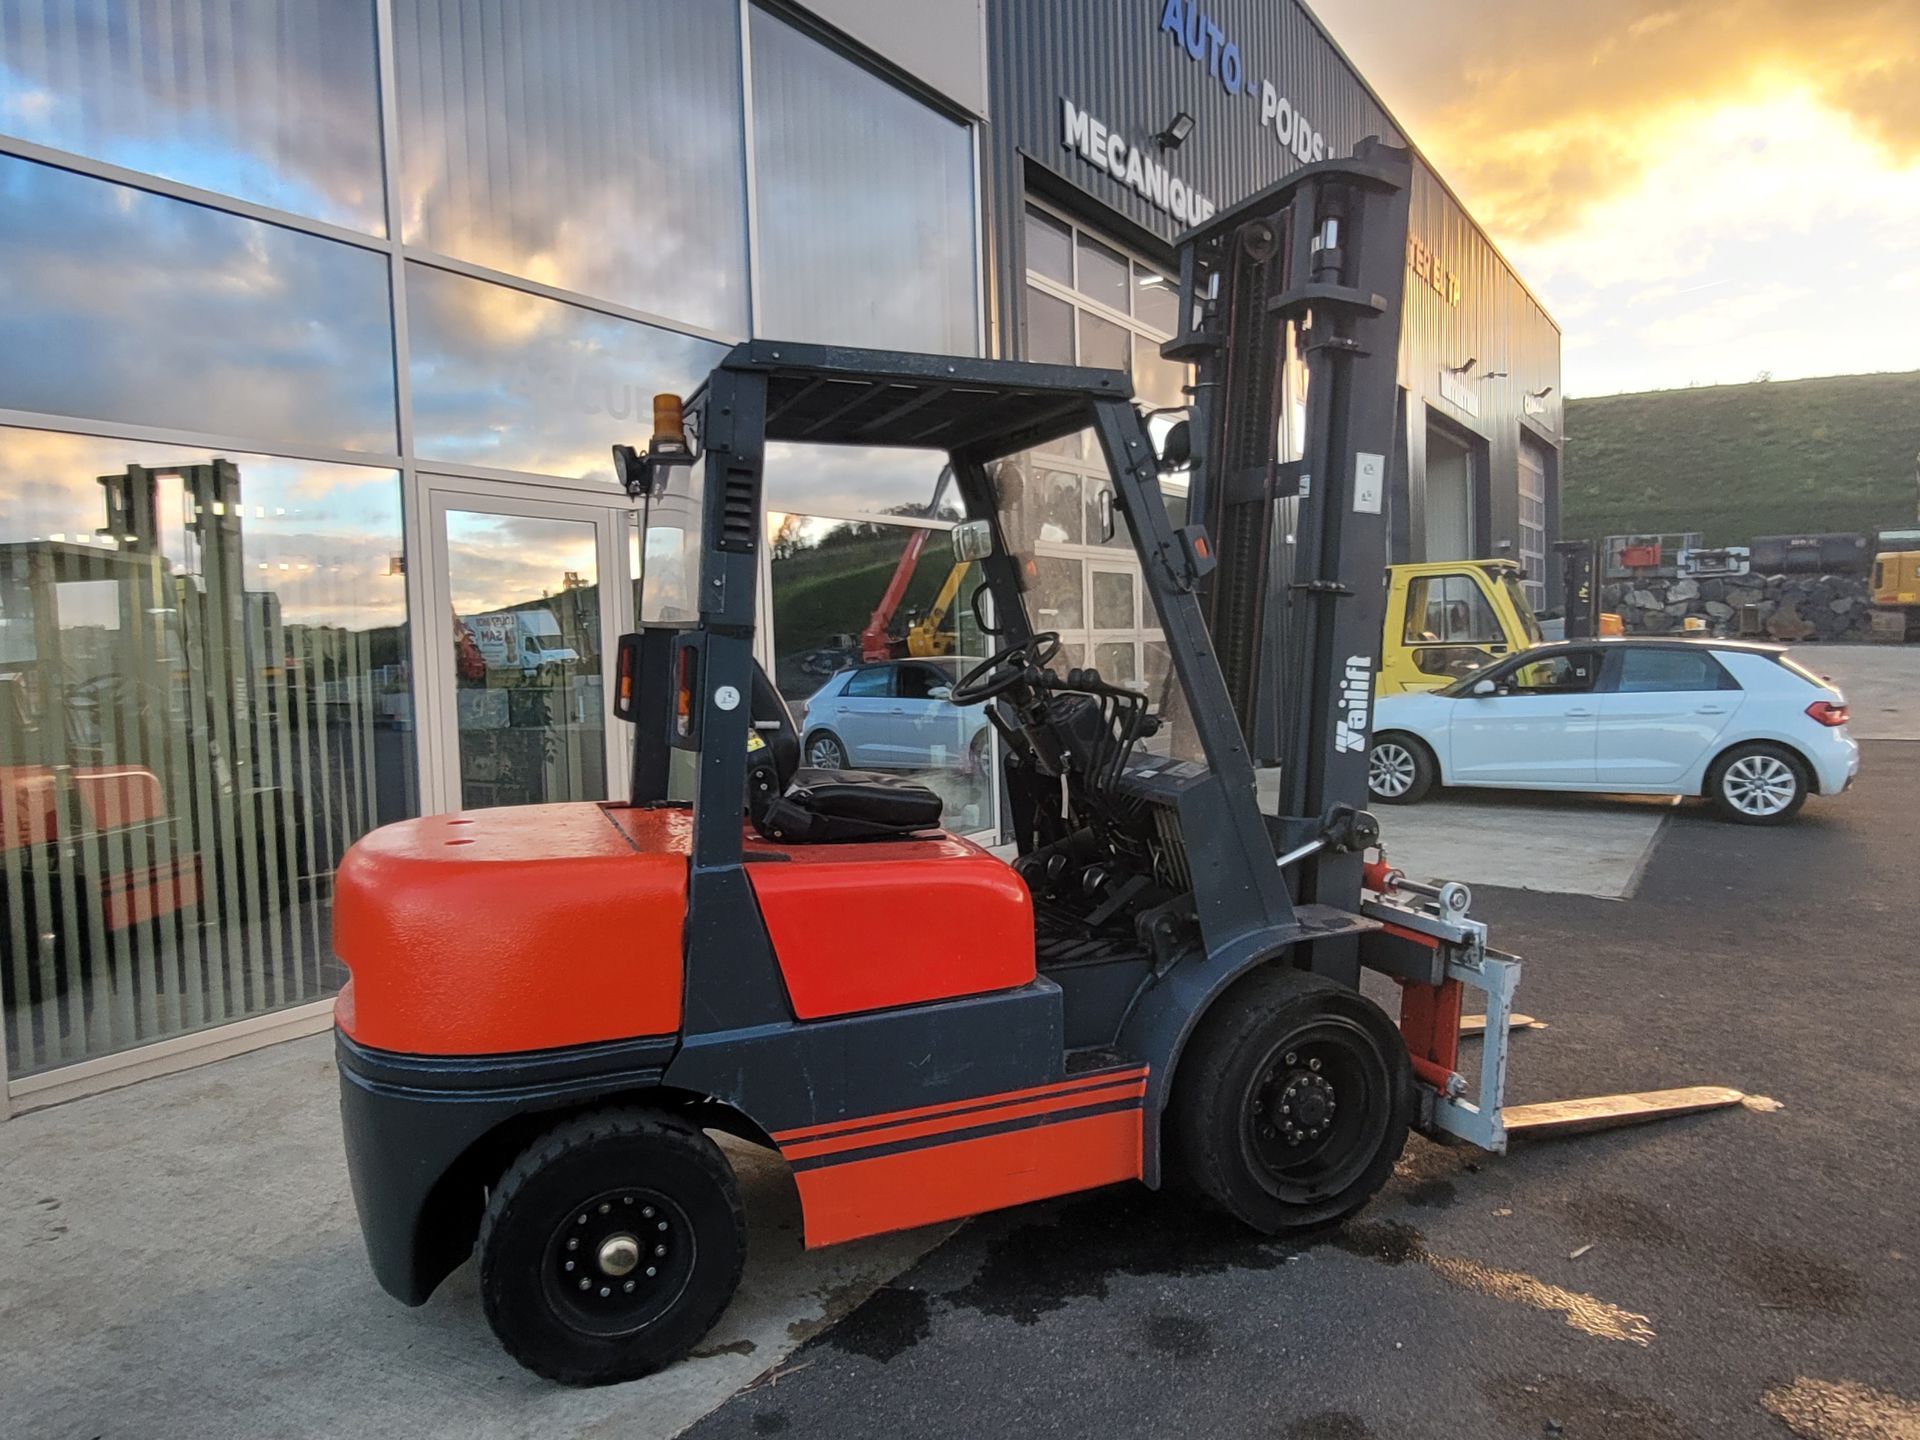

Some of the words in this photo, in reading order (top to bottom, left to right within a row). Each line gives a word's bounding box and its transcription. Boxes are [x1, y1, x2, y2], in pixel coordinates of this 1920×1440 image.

[1160, 0, 1242, 95] AUTO
[1261, 79, 1324, 164] POIDS
[1063, 100, 1216, 227] MECANIQUE
